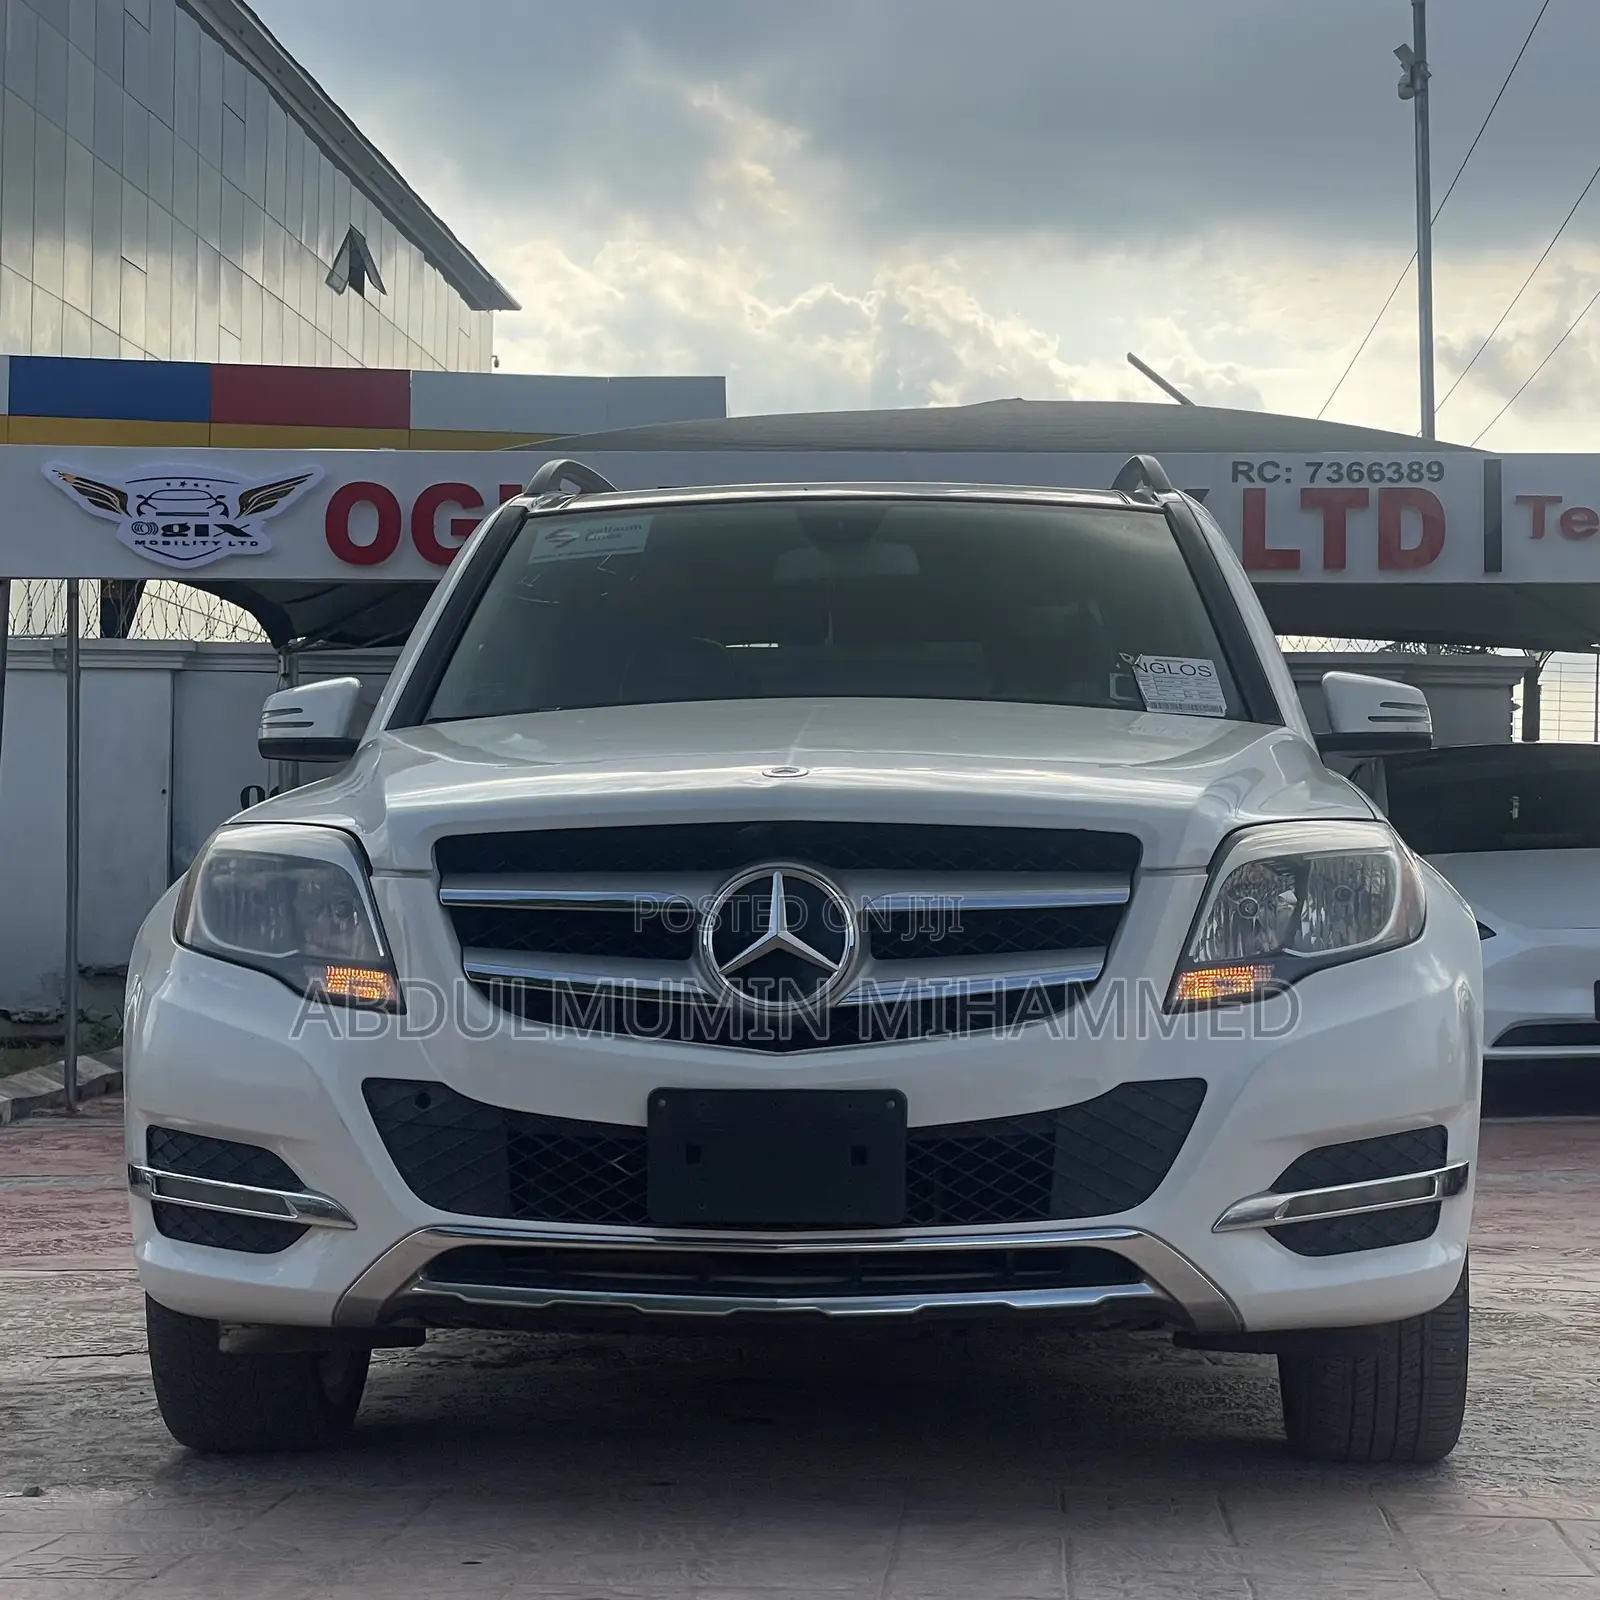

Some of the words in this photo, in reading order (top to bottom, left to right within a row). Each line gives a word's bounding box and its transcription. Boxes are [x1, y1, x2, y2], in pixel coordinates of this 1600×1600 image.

[1231, 461, 1292, 483] RC:
[1305, 461, 1445, 484] 7366389
[325, 481, 523, 566] OG
[1242, 487, 1446, 571] LTD
[134, 539, 221, 547] MOBILITY
